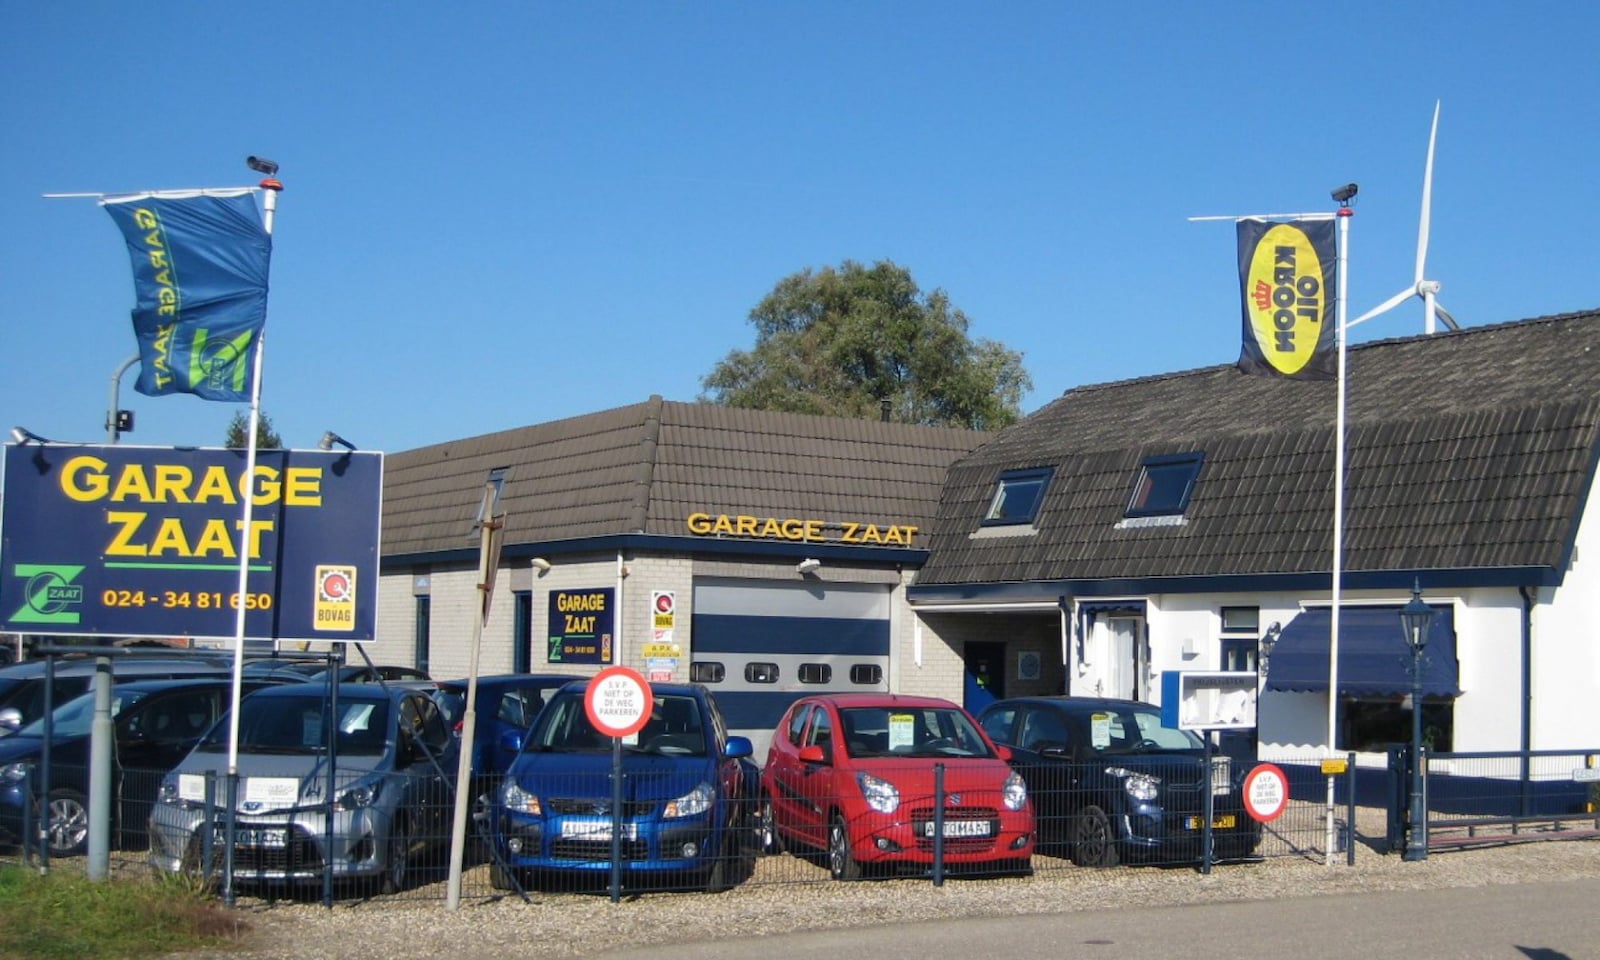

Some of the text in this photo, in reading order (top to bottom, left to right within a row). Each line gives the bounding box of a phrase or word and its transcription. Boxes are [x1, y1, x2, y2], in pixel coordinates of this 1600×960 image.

[60, 455, 323, 507] GARAGE
[104, 511, 275, 558] ZAAT
[687, 512, 918, 545] GARAGE ZAAT
[49, 588, 80, 599] ZAAT
[103, 589, 146, 607] 024
[163, 591, 191, 608] 34
[197, 592, 222, 609] 81
[229, 593, 272, 610] 650
[557, 592, 605, 612] GARAGE
[318, 609, 352, 622] BOVAG
[564, 614, 596, 633] ZAAT
[623, 690, 634, 698] OP
[604, 699, 634, 708] DE WEG
[599, 708, 639, 716] PARKEREN
[926, 822, 990, 835] ATOMART
